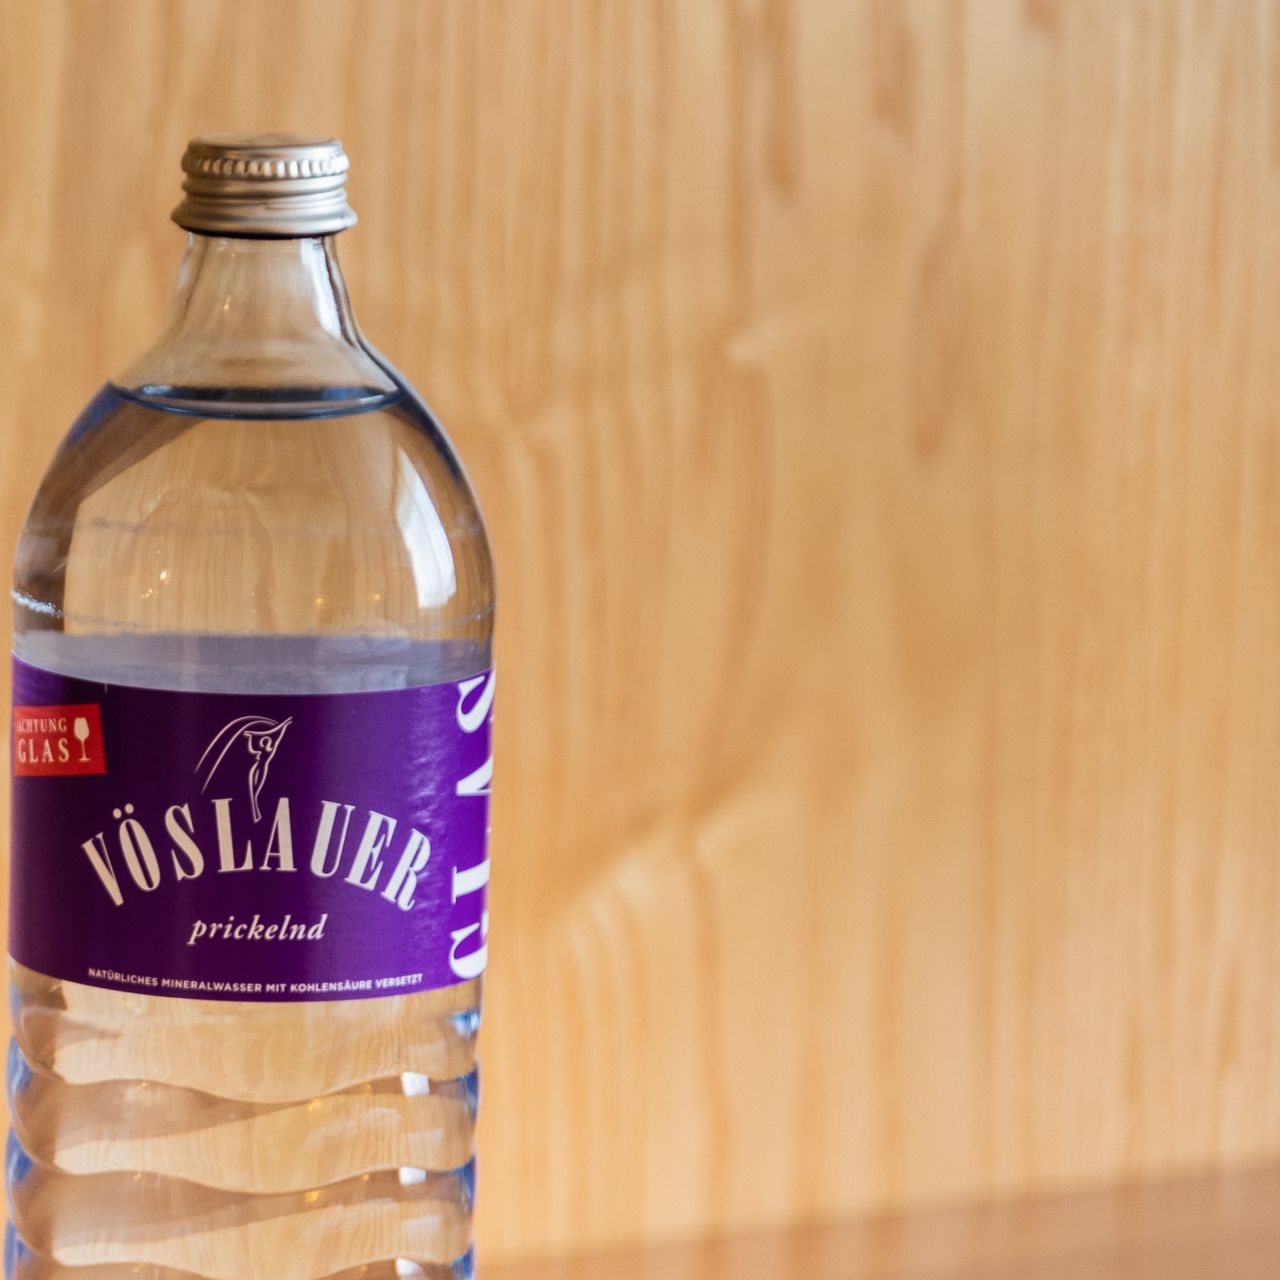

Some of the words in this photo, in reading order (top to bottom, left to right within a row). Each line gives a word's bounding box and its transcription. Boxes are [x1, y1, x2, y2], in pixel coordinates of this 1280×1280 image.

[18, 737, 70, 763] GLAS
[81, 797, 433, 912] VÖSLAUER
[186, 913, 329, 946] prickelnd
[88, 967, 159, 987] NATÜRLICHES
[161, 978, 263, 993] MINERALWASSER
[265, 983, 287, 993] MIT
[290, 978, 373, 993] KOHLENSÄURE
[375, 972, 424, 989] VERSETZT
